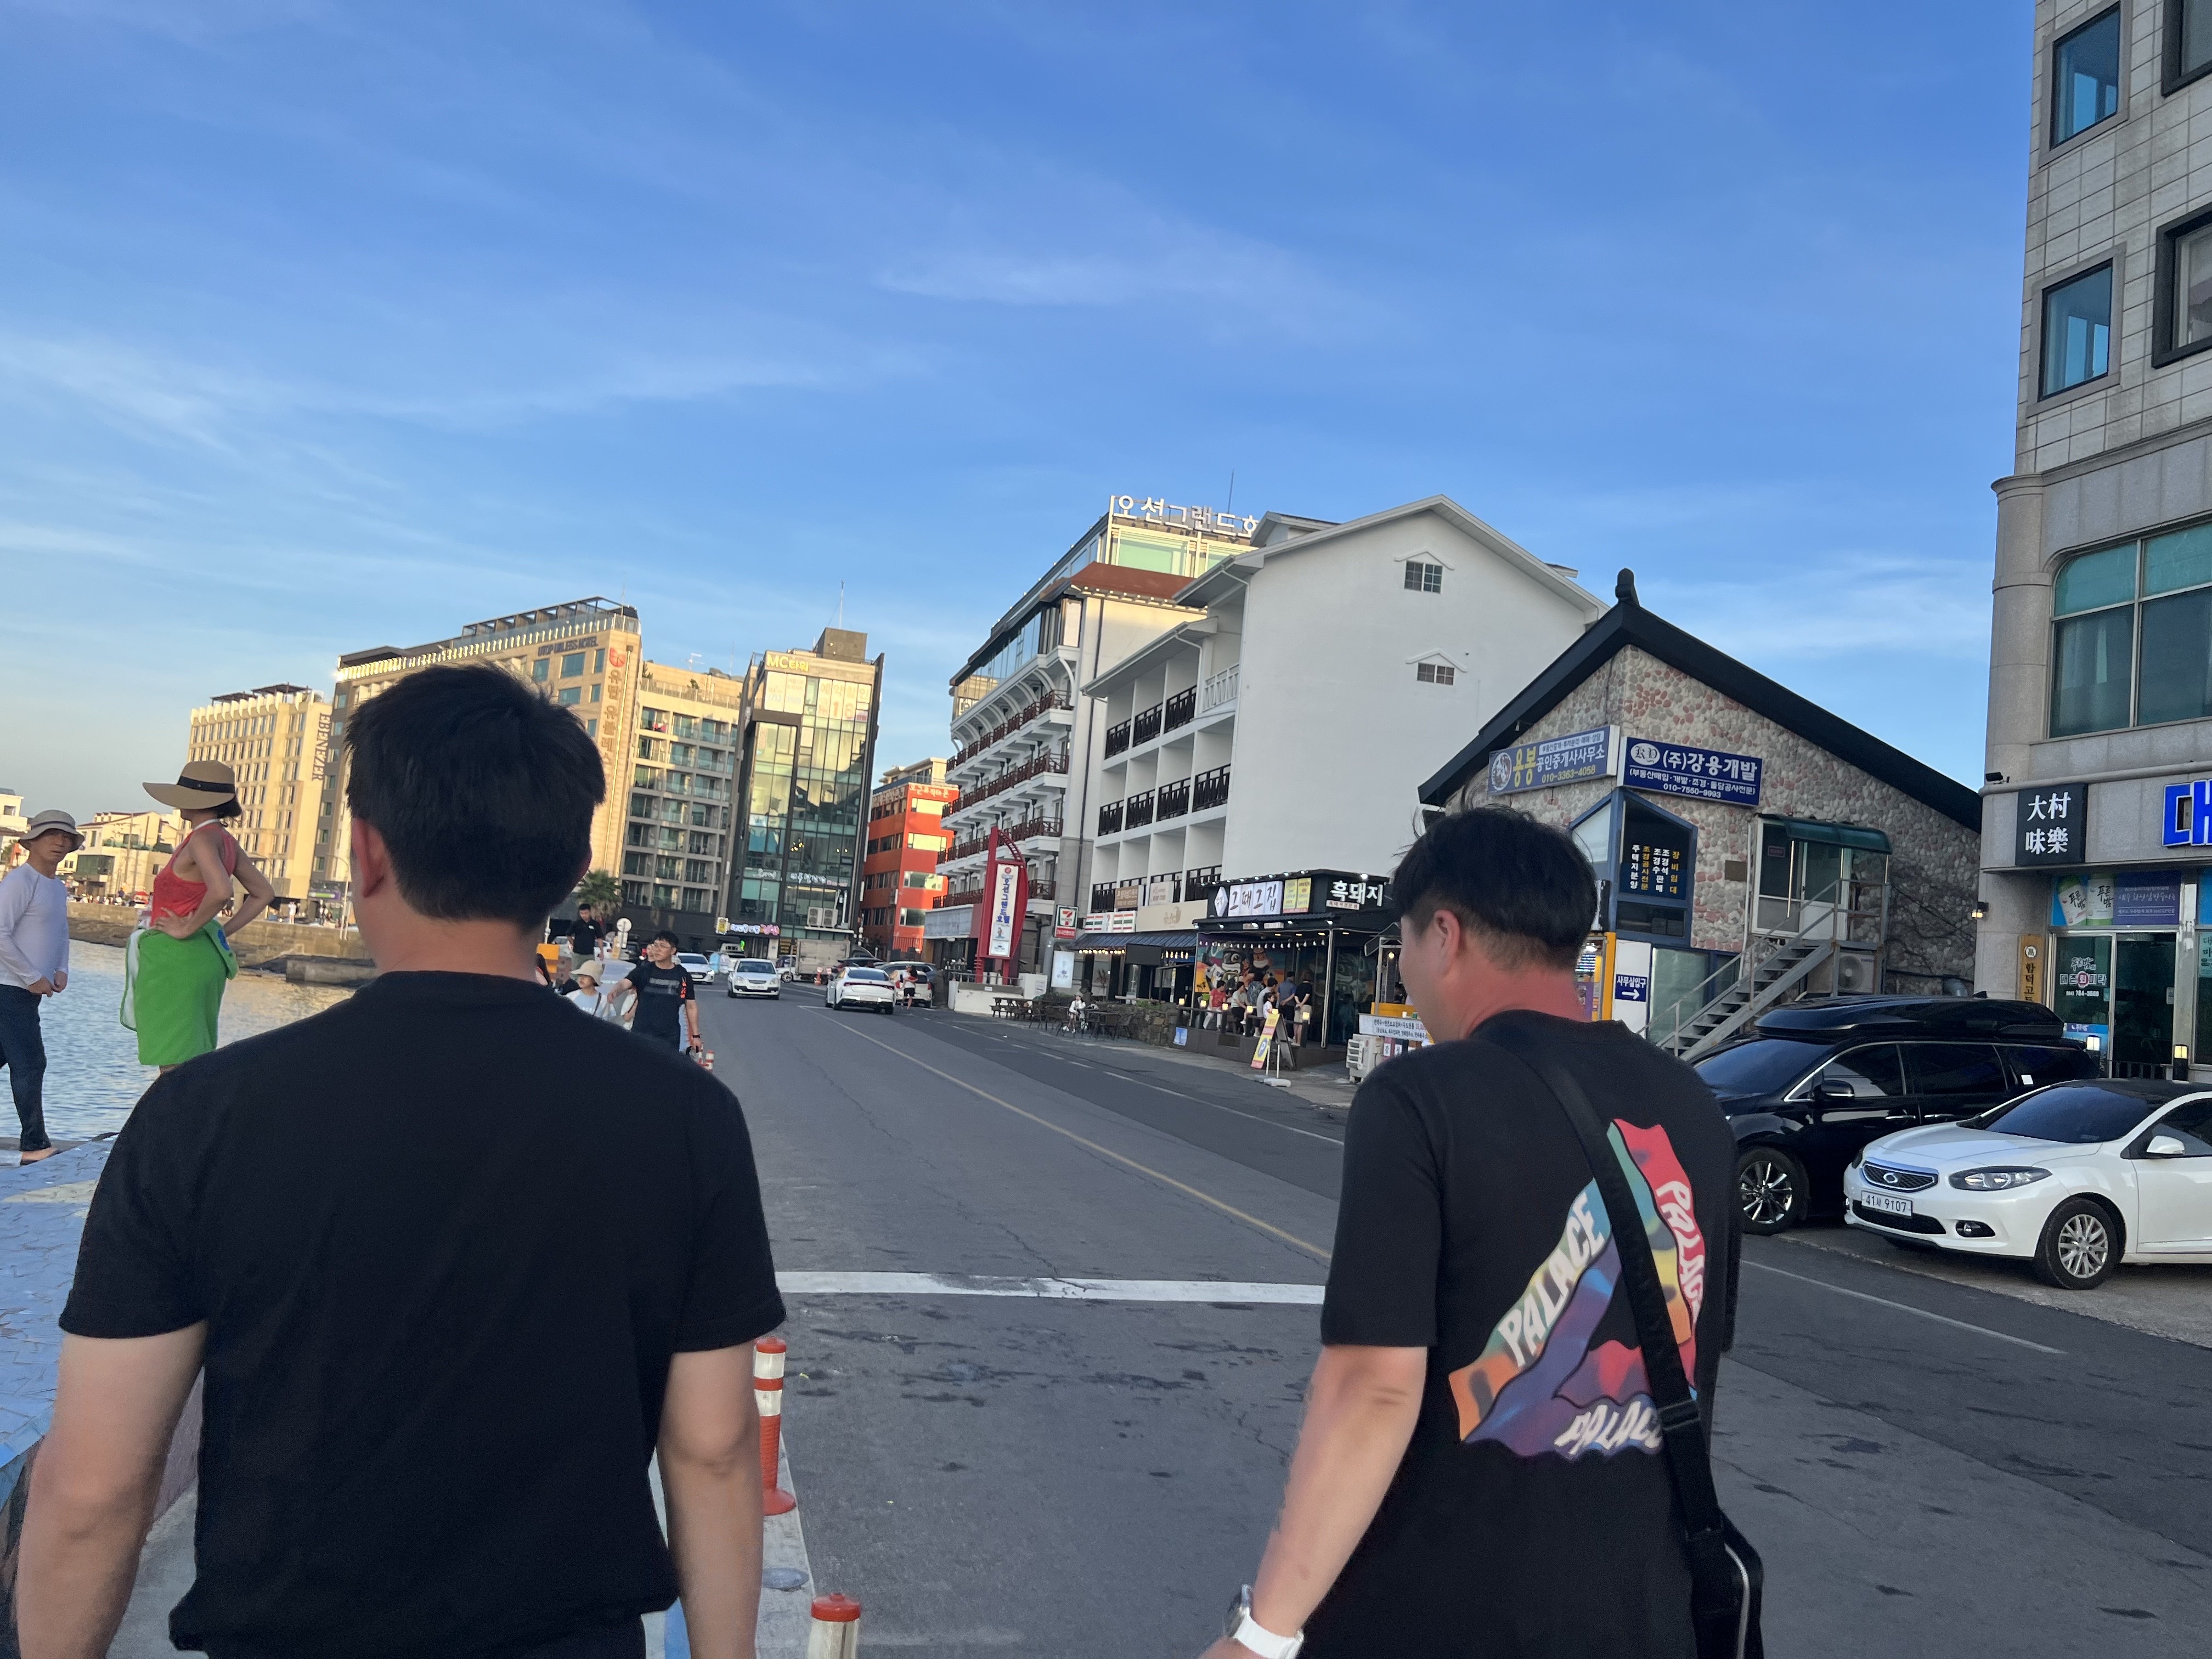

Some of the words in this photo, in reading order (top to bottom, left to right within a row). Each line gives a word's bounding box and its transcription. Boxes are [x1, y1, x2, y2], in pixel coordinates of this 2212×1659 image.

[578, 636, 598, 649] HOTEL
[766, 653, 809, 672] MC타워
[312, 713, 330, 781] EBENEZER
[1536, 744, 1605, 772] 공인중개사사무소
[1513, 746, 1537, 787] 용봉
[1542, 765, 1596, 784] 010-3363-4058
[1663, 750, 1757, 782] (주)강용개발
[1663, 783, 1721, 798] 010-7550-9993
[2027, 792, 2071, 821] 大村
[2025, 827, 2068, 855] 味樂
[1630, 845, 1640, 889] 주택지분양
[1652, 848, 1661, 874] 조경수
[1661, 849, 1670, 875] 조경석
[1669, 851, 1680, 894] 장비임대
[1330, 880, 1383, 906] 흑돼지
[1656, 875, 1664, 892] 판매
[2097, 885, 2111, 902] 푸른
[1229, 883, 1277, 912] 그때그집
[2103, 897, 2114, 908] 밤
[1617, 975, 1646, 989] 사무실입구
[1884, 1198, 1906, 1212] 9107
[1498, 1191, 1605, 1368] PALACE
